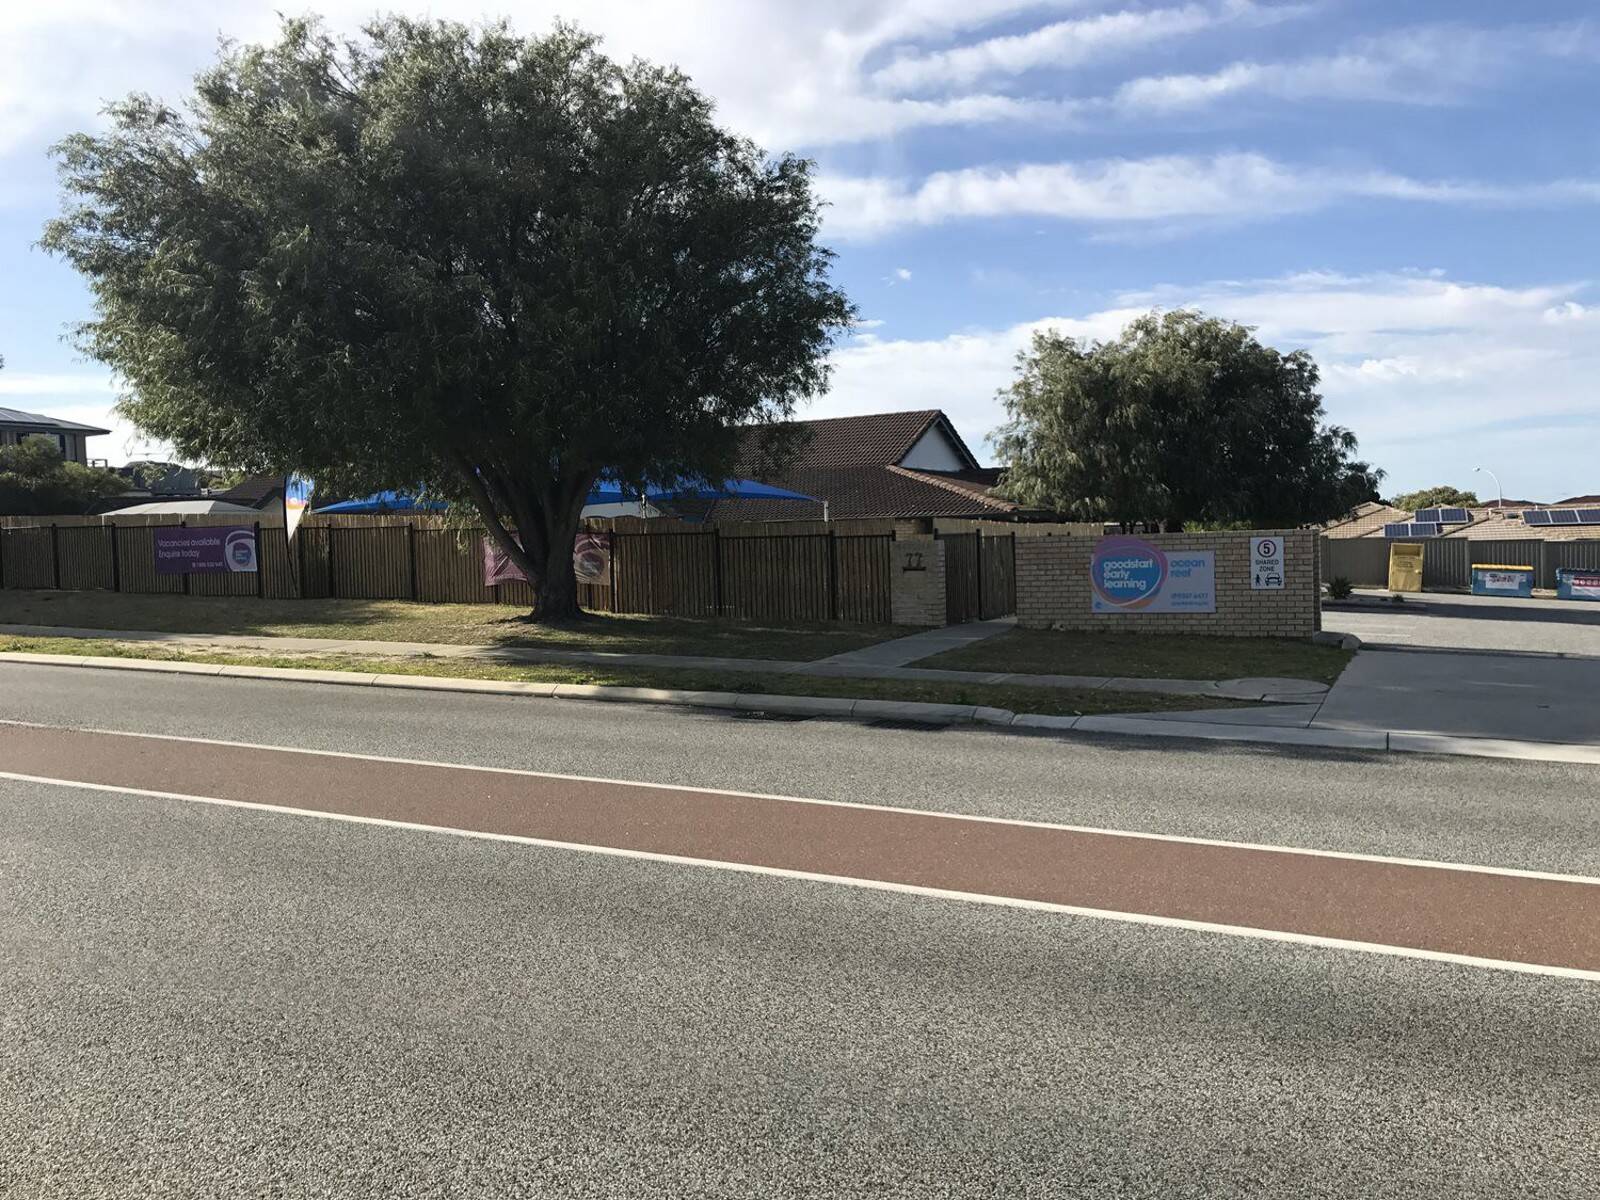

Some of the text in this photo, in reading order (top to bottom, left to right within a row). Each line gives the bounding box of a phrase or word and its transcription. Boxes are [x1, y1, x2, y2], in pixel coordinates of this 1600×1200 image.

[158, 537, 220, 547] Vacancies available
[1263, 543, 1271, 554] 5
[181, 550, 200, 559] today
[1103, 558, 1153, 571] goodstart
[1170, 559, 1206, 568] ocean
[1103, 570, 1131, 580] early
[1170, 567, 1192, 577] reef
[1103, 579, 1147, 591] learning
